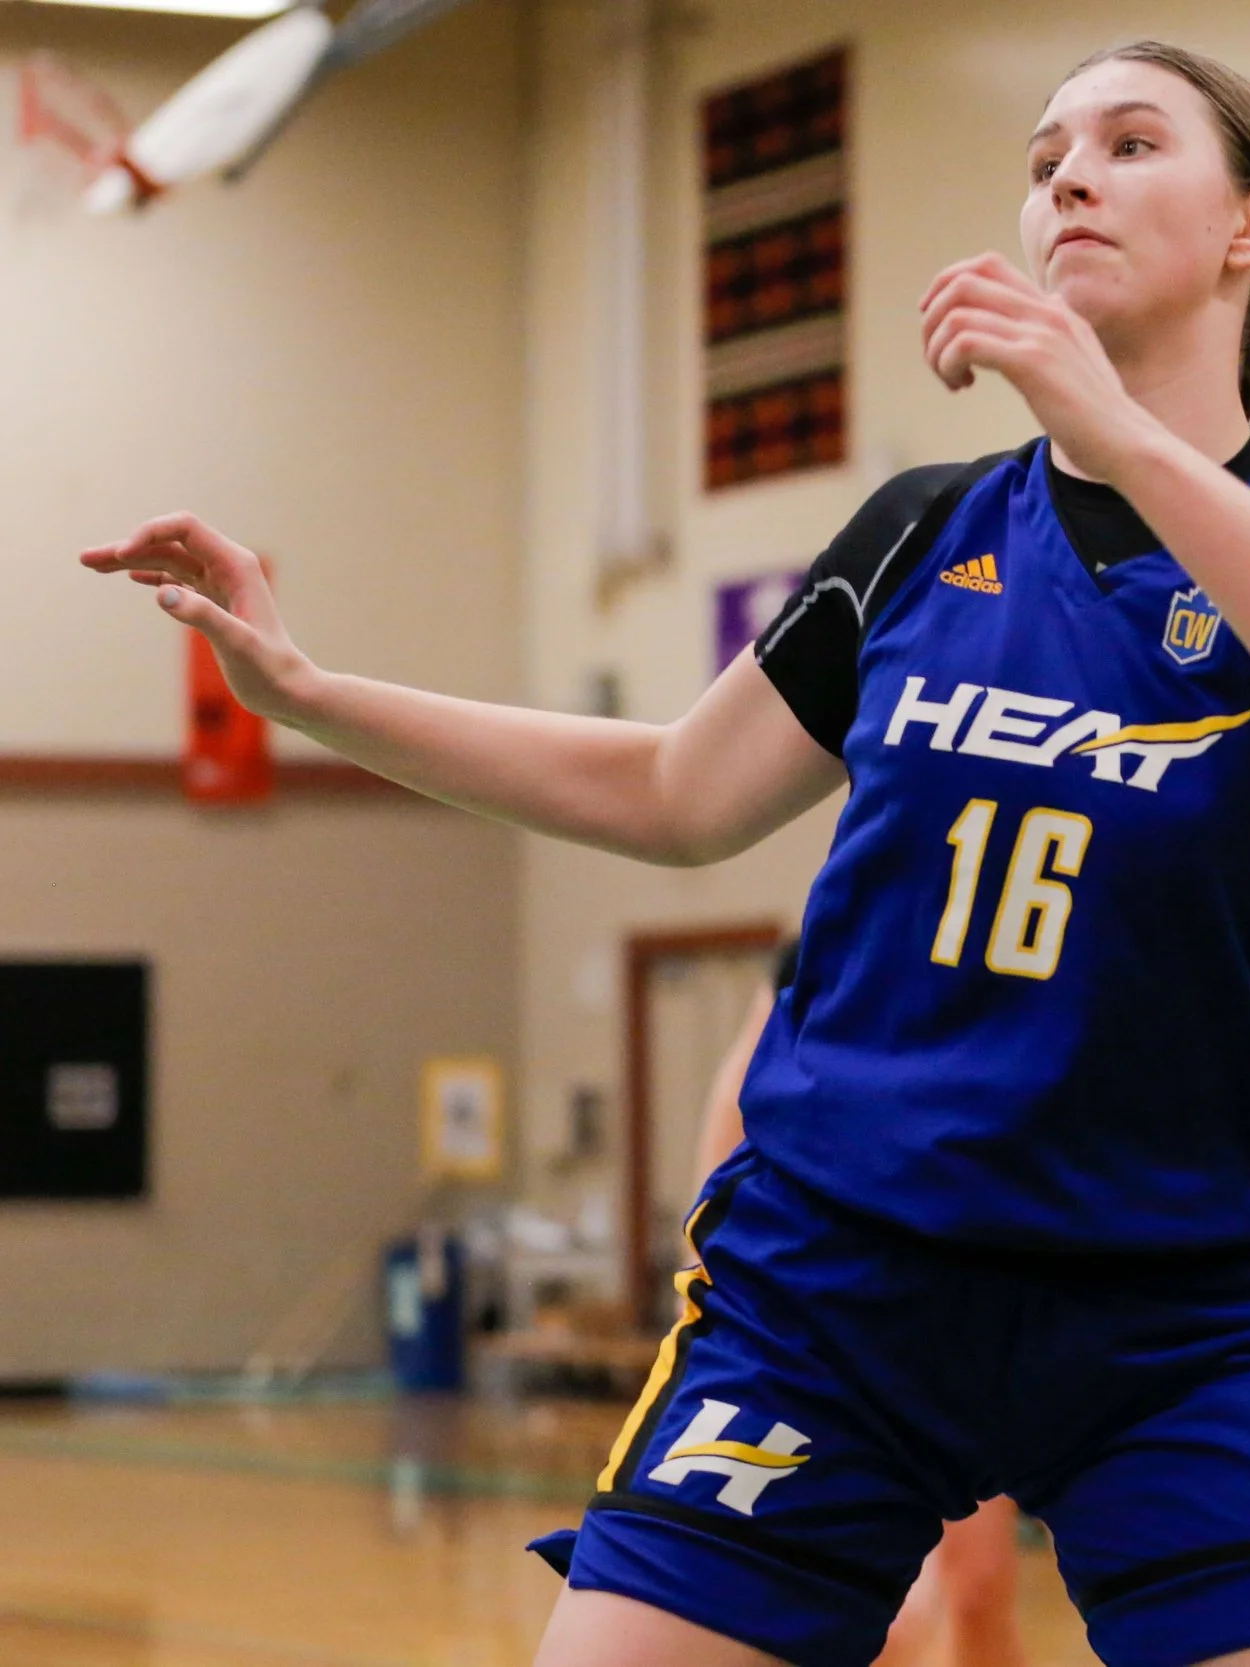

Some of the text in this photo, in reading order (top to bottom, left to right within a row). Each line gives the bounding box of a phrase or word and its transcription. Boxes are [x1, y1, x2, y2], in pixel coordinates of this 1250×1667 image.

[940, 571, 1003, 594] adidas
[1170, 609, 1216, 651] CW
[930, 798, 1093, 981] 16
